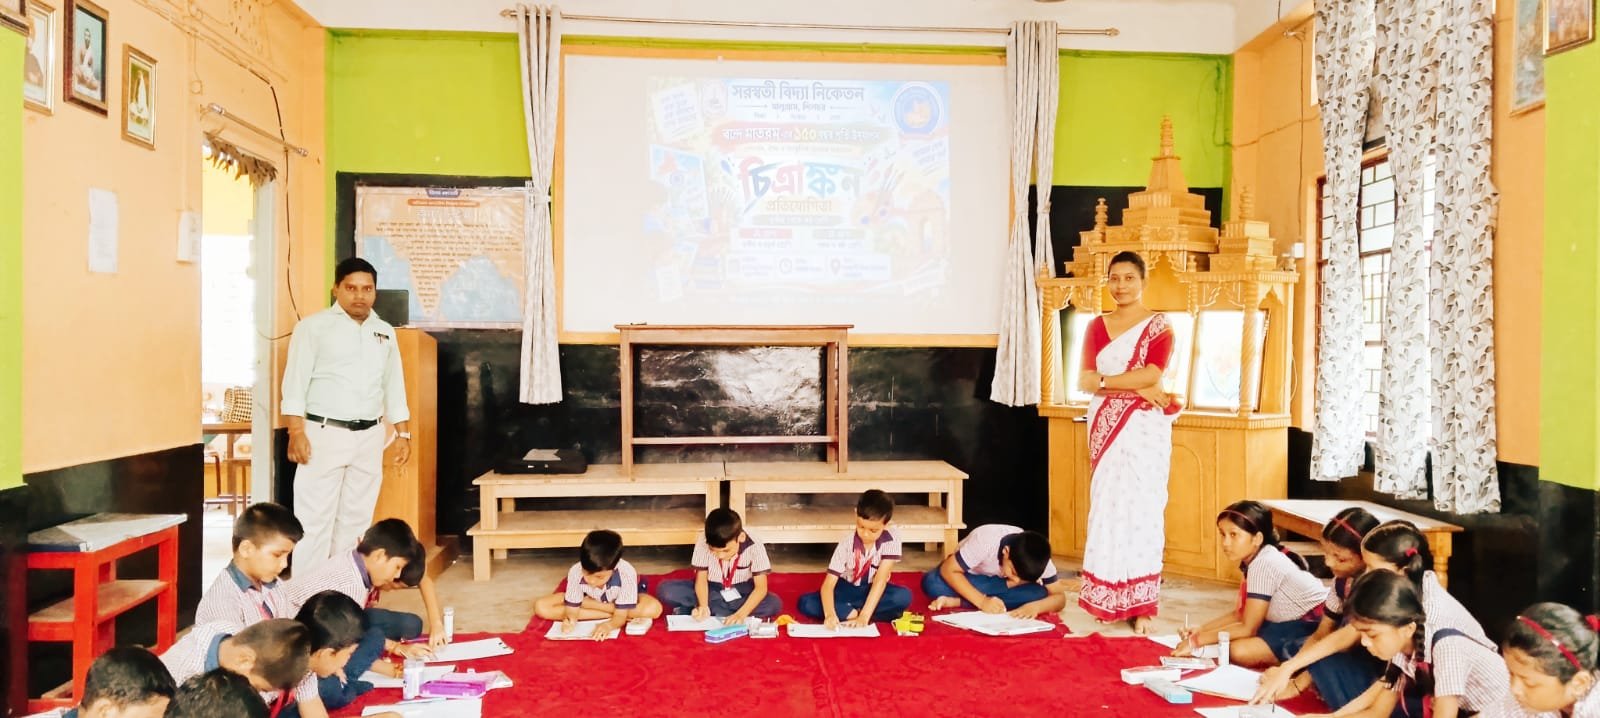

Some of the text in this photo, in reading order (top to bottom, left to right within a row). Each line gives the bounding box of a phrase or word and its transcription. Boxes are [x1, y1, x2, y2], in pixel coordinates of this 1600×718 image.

[731, 80, 865, 102] সরস্বতী বিদ্যা নিকেতন
[793, 127, 817, 141] ১৫০
[738, 155, 864, 202] চিত্রাঙ্কন
